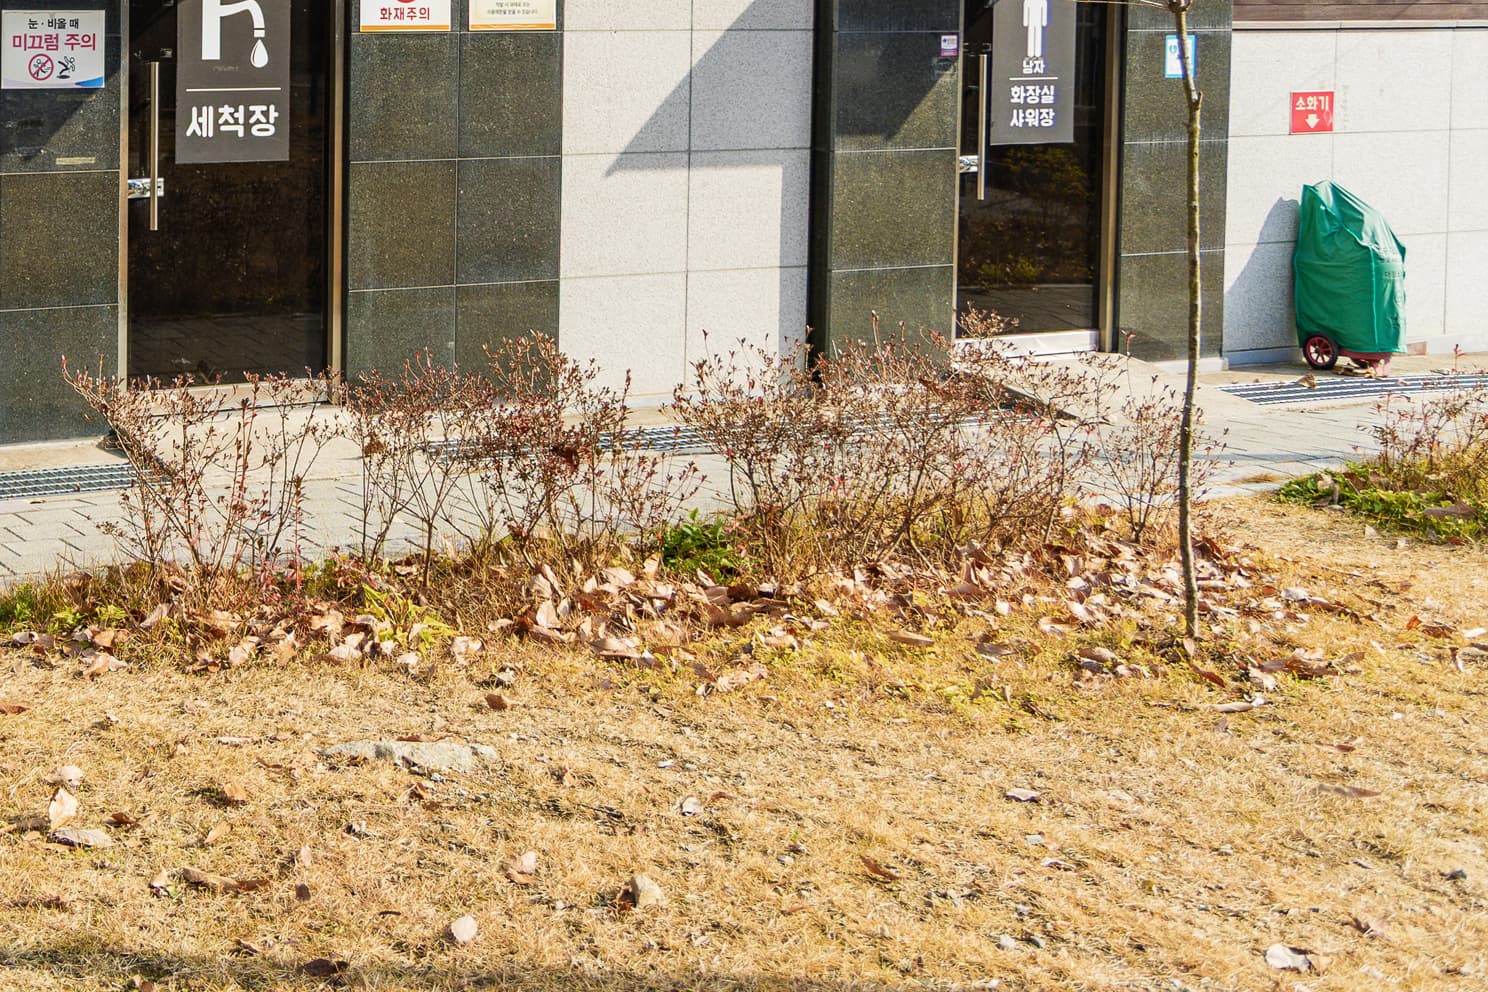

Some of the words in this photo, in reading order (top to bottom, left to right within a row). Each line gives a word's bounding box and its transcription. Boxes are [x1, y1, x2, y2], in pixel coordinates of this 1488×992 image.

[380, 7, 430, 21] 화재주의
[69, 18, 79, 29] 때
[12, 33, 59, 51] 미끄럼
[64, 33, 96, 51] 주의
[1022, 59, 1045, 74] 남자
[1010, 85, 1055, 104] 화장실
[1295, 95, 1329, 111] 소화기
[185, 104, 279, 138] 세척장
[1010, 108, 1055, 127] 샤워장
